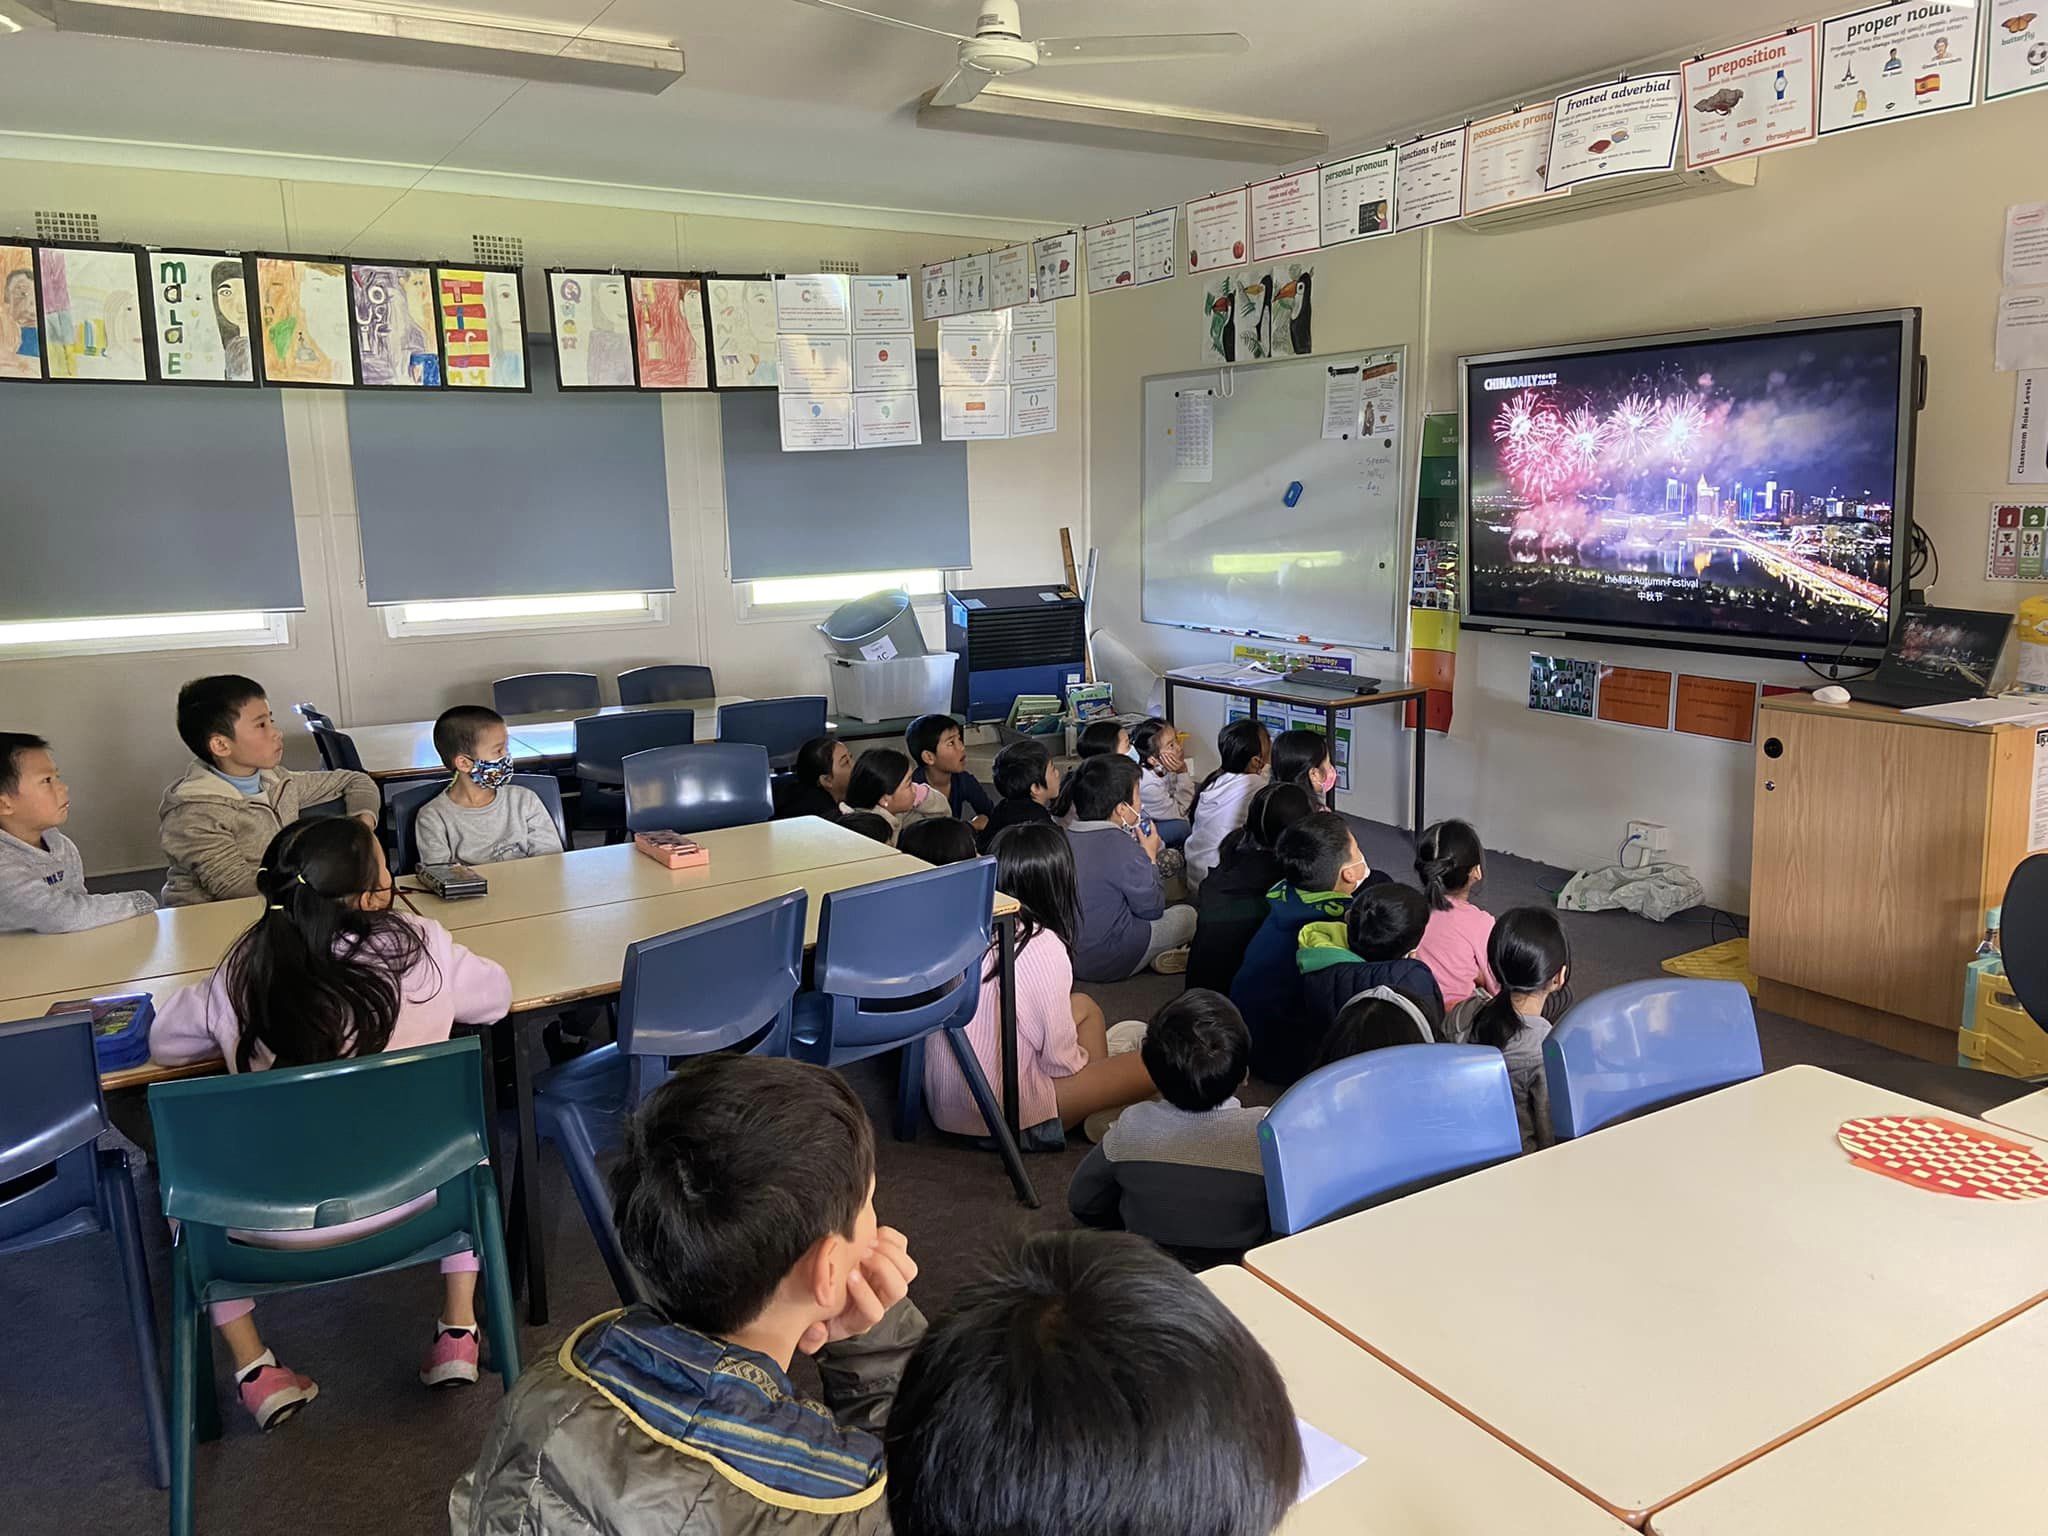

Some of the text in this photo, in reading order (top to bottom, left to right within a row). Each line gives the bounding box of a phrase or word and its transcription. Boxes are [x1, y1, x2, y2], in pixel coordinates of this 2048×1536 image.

[1847, 13, 1901, 42] proper
[2001, 32, 2035, 46] butterfly
[1708, 46, 1787, 81] preposition
[2030, 66, 2045, 75] ball
[1565, 80, 1671, 115] fronted adverbial
[1473, 119, 1521, 143] possessive
[1766, 127, 1806, 141] throughout
[1431, 141, 1439, 153] of
[1440, 139, 1456, 149] time
[1325, 164, 1354, 184] personal
[1355, 159, 1388, 176] pronoun
[1484, 374, 1538, 391] CHINADAILY
[2017, 378, 2032, 474] Classroom Noise Levels
[2006, 514, 2013, 525] 1
[2030, 514, 2039, 525] 2
[1604, 574, 1616, 584] the
[1667, 577, 1698, 589] Festival
[1637, 591, 1663, 602] 中秋节
